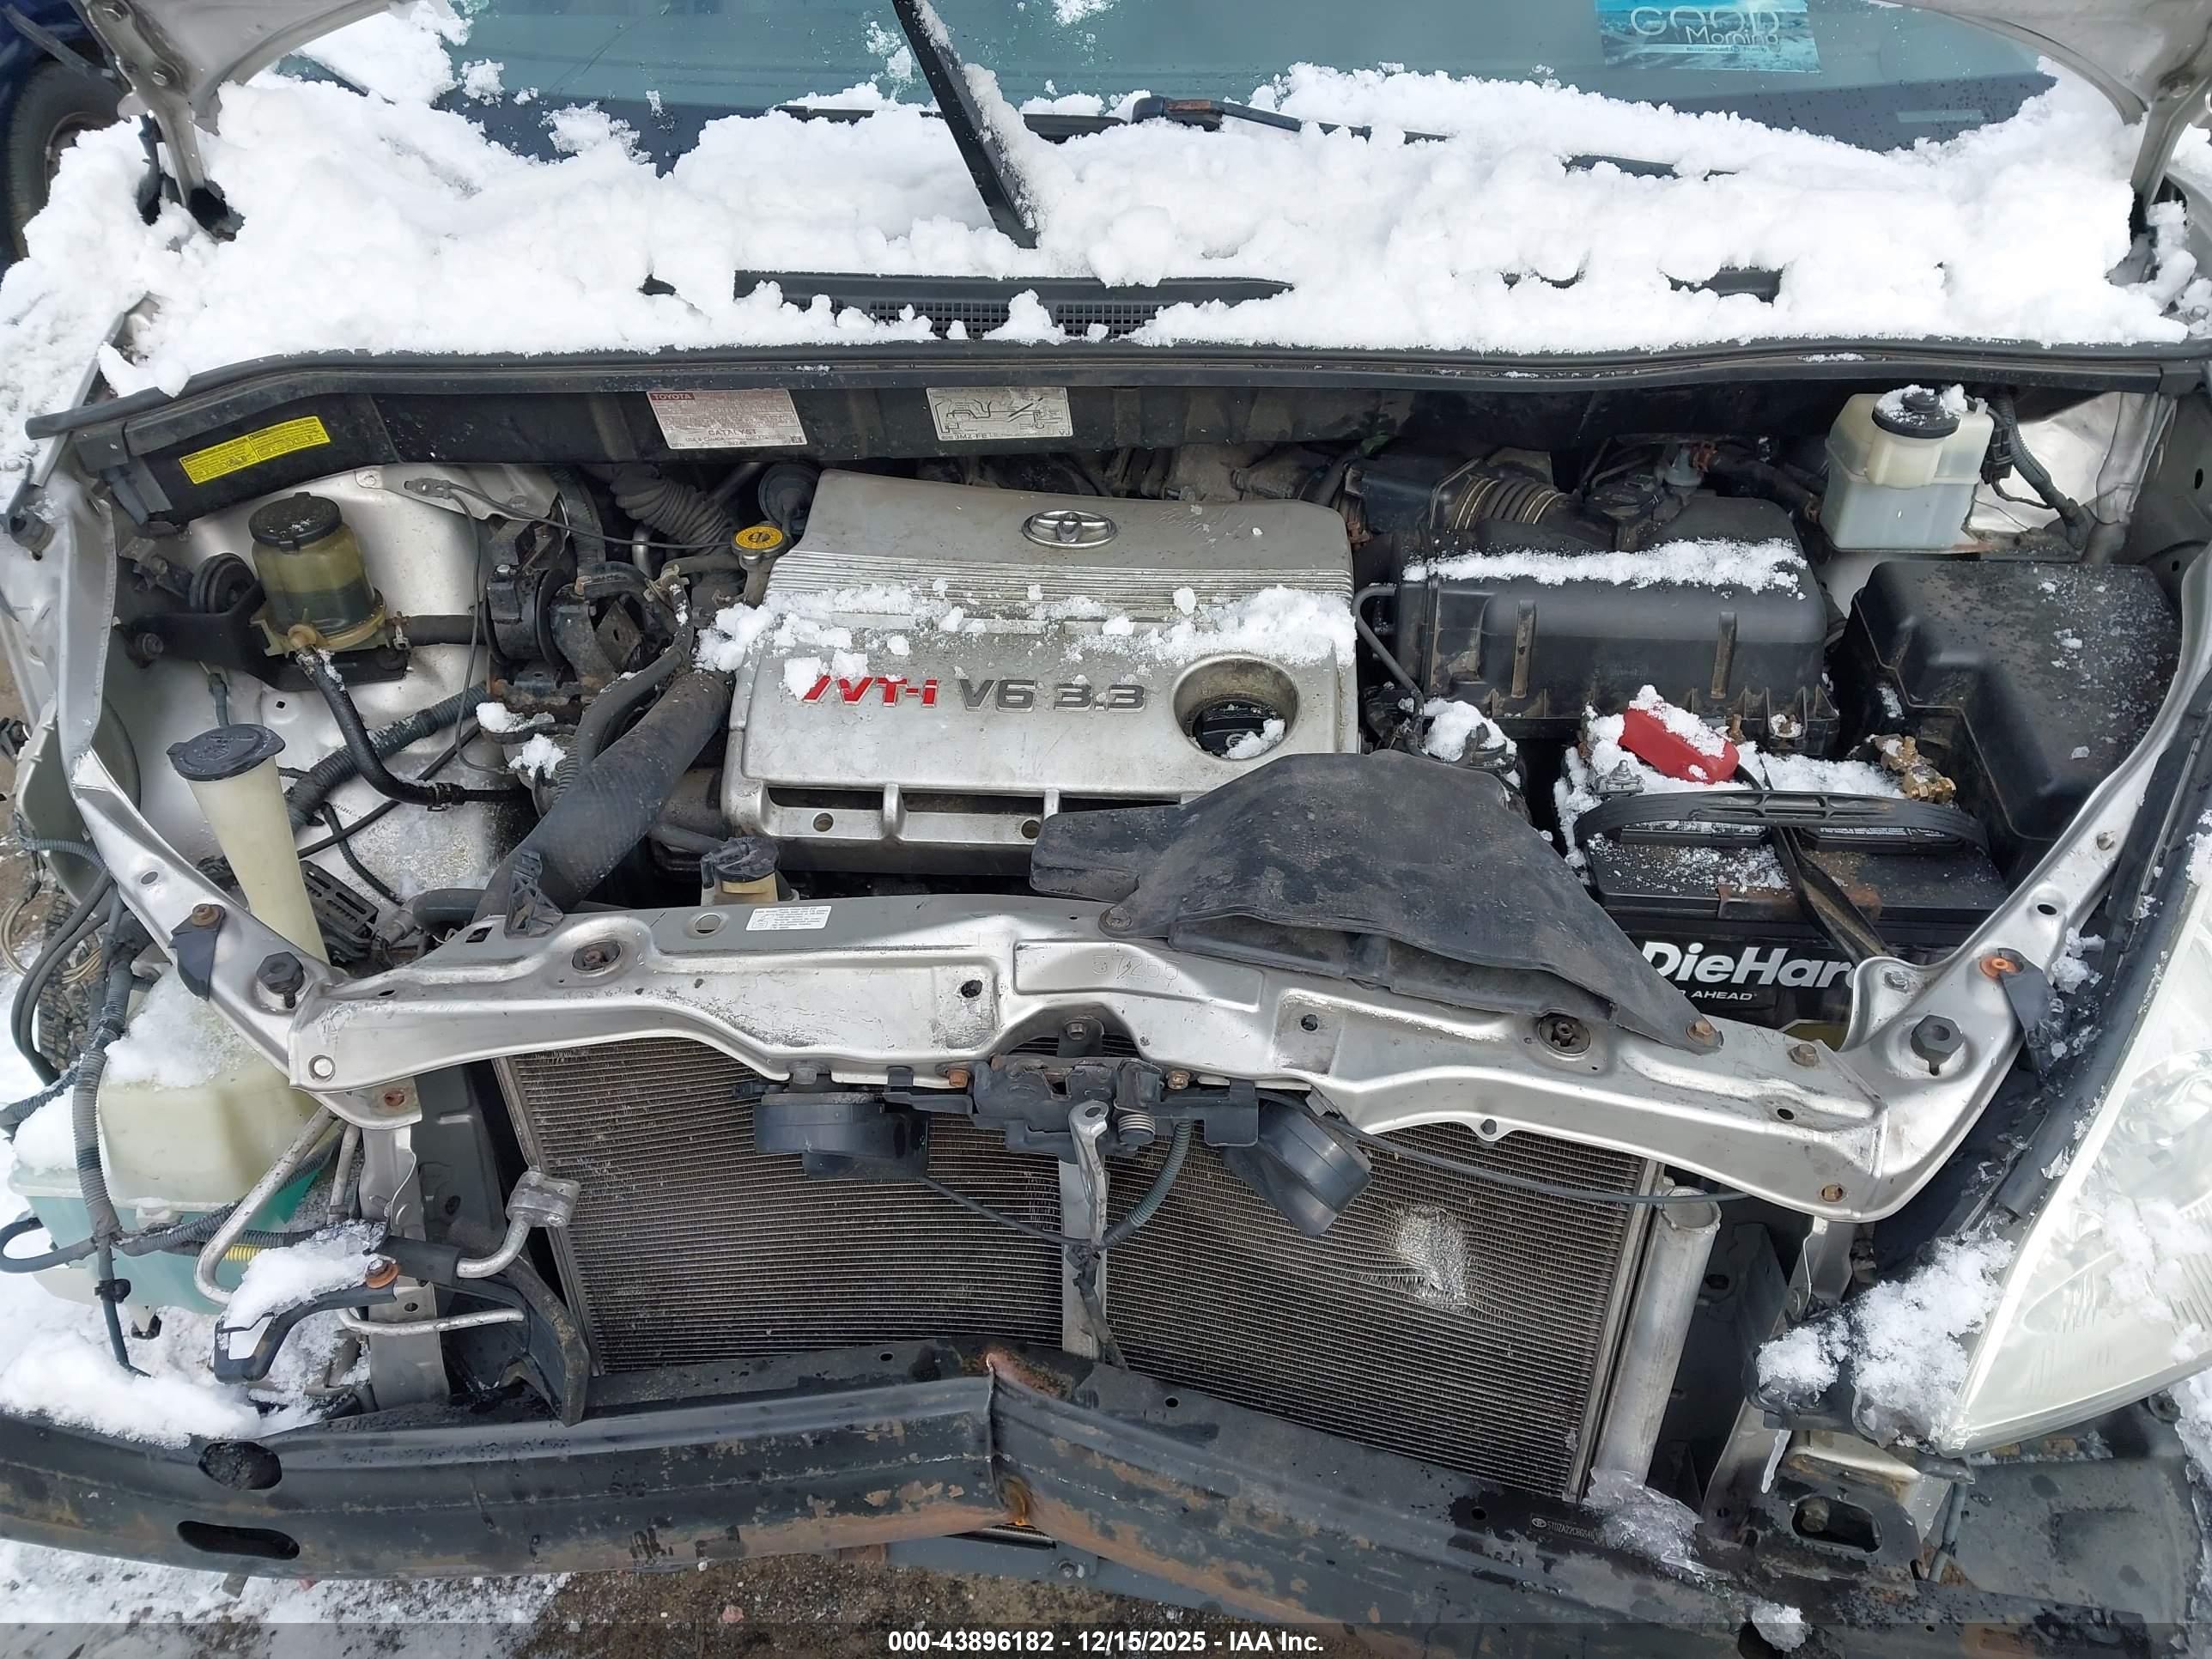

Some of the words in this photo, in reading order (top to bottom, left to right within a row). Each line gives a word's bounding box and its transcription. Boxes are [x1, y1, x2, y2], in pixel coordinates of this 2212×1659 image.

[1631, 6, 1779, 36] GOOD
[1686, 26, 1780, 47] Morning
[958, 678, 1036, 712] V6
[1054, 684, 1146, 713] 3.3
[1691, 989, 1753, 1001] AHEAD
